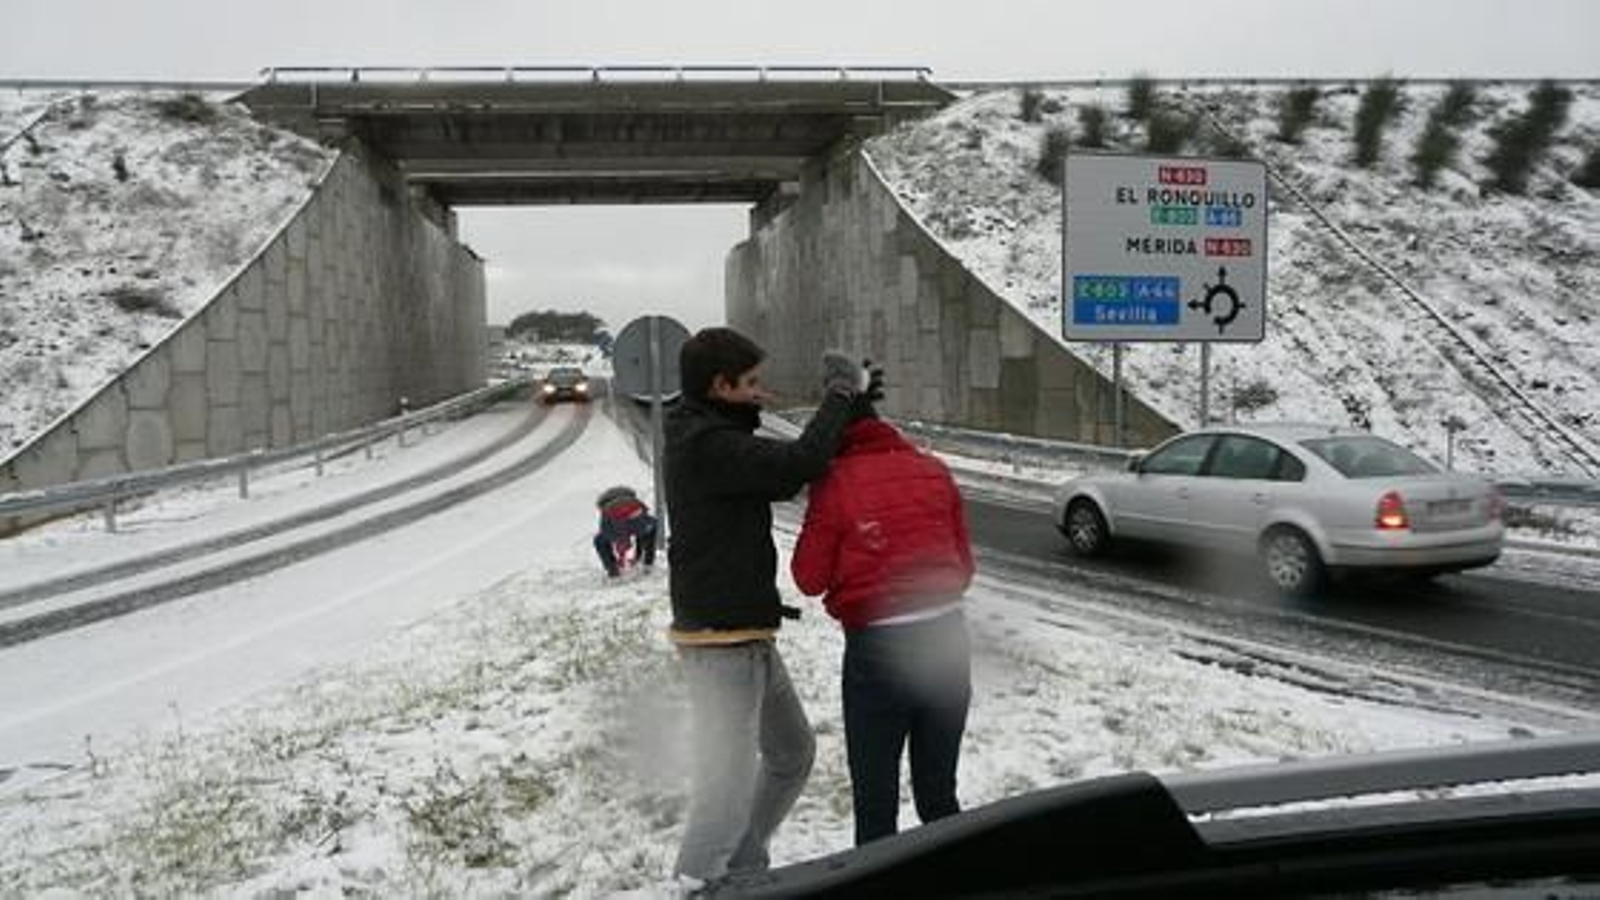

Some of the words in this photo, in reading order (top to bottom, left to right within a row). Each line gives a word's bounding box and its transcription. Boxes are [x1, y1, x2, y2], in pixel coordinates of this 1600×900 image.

[1116, 187, 1138, 203] EL
[1147, 189, 1255, 208] RONQUILLO
[1095, 303, 1157, 321] Sevilla
